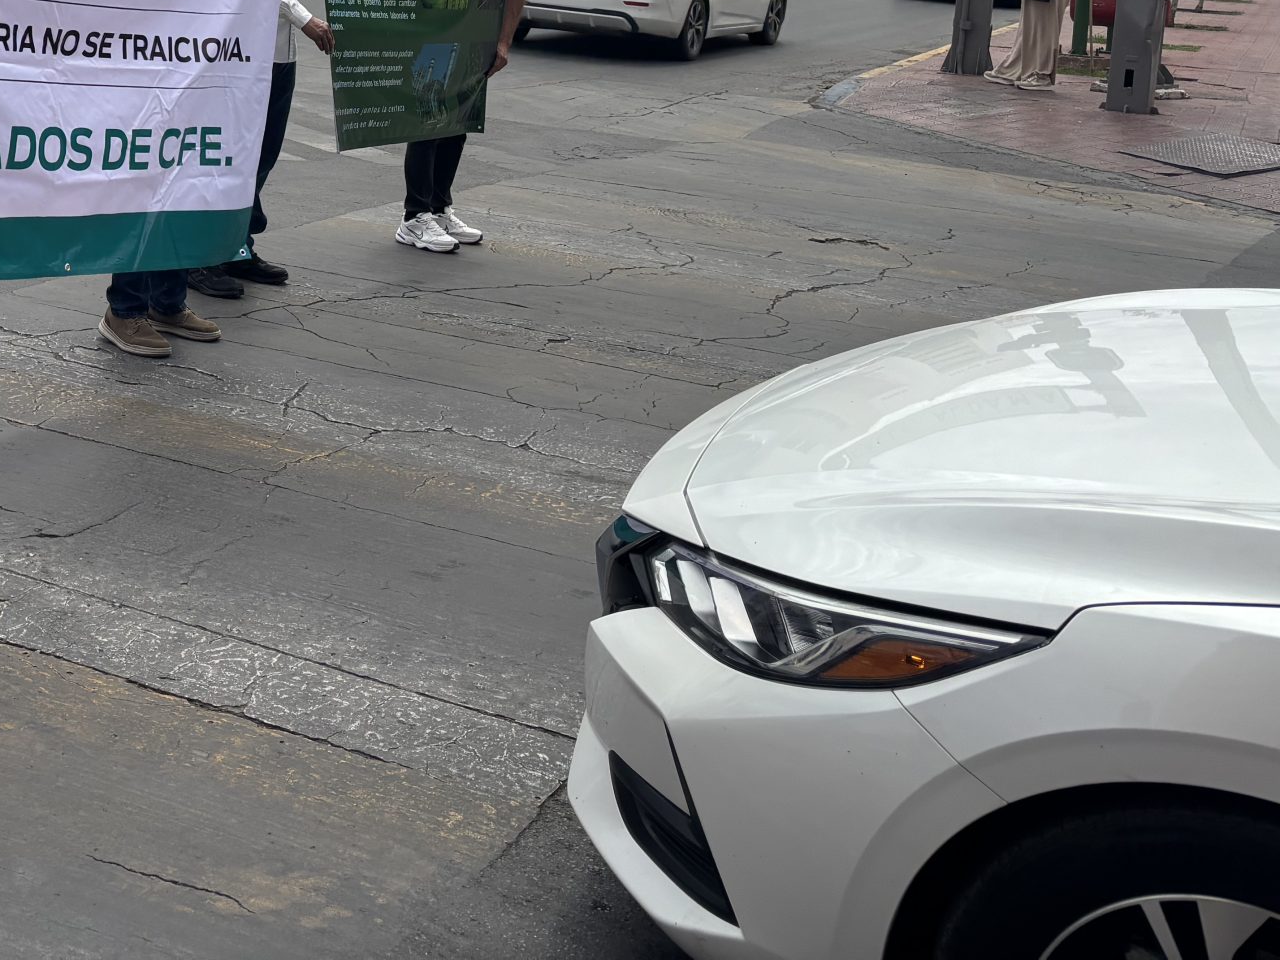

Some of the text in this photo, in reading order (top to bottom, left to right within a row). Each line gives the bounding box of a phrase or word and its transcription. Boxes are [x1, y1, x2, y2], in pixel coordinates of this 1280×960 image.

[369, 10, 389, 19] derechos
[410, 11, 416, 20] de
[41, 27, 80, 57] NO
[82, 31, 115, 59] SE
[118, 33, 251, 63] TRAICIONA.
[101, 128, 153, 171] DE
[158, 126, 233, 170] CFE.
